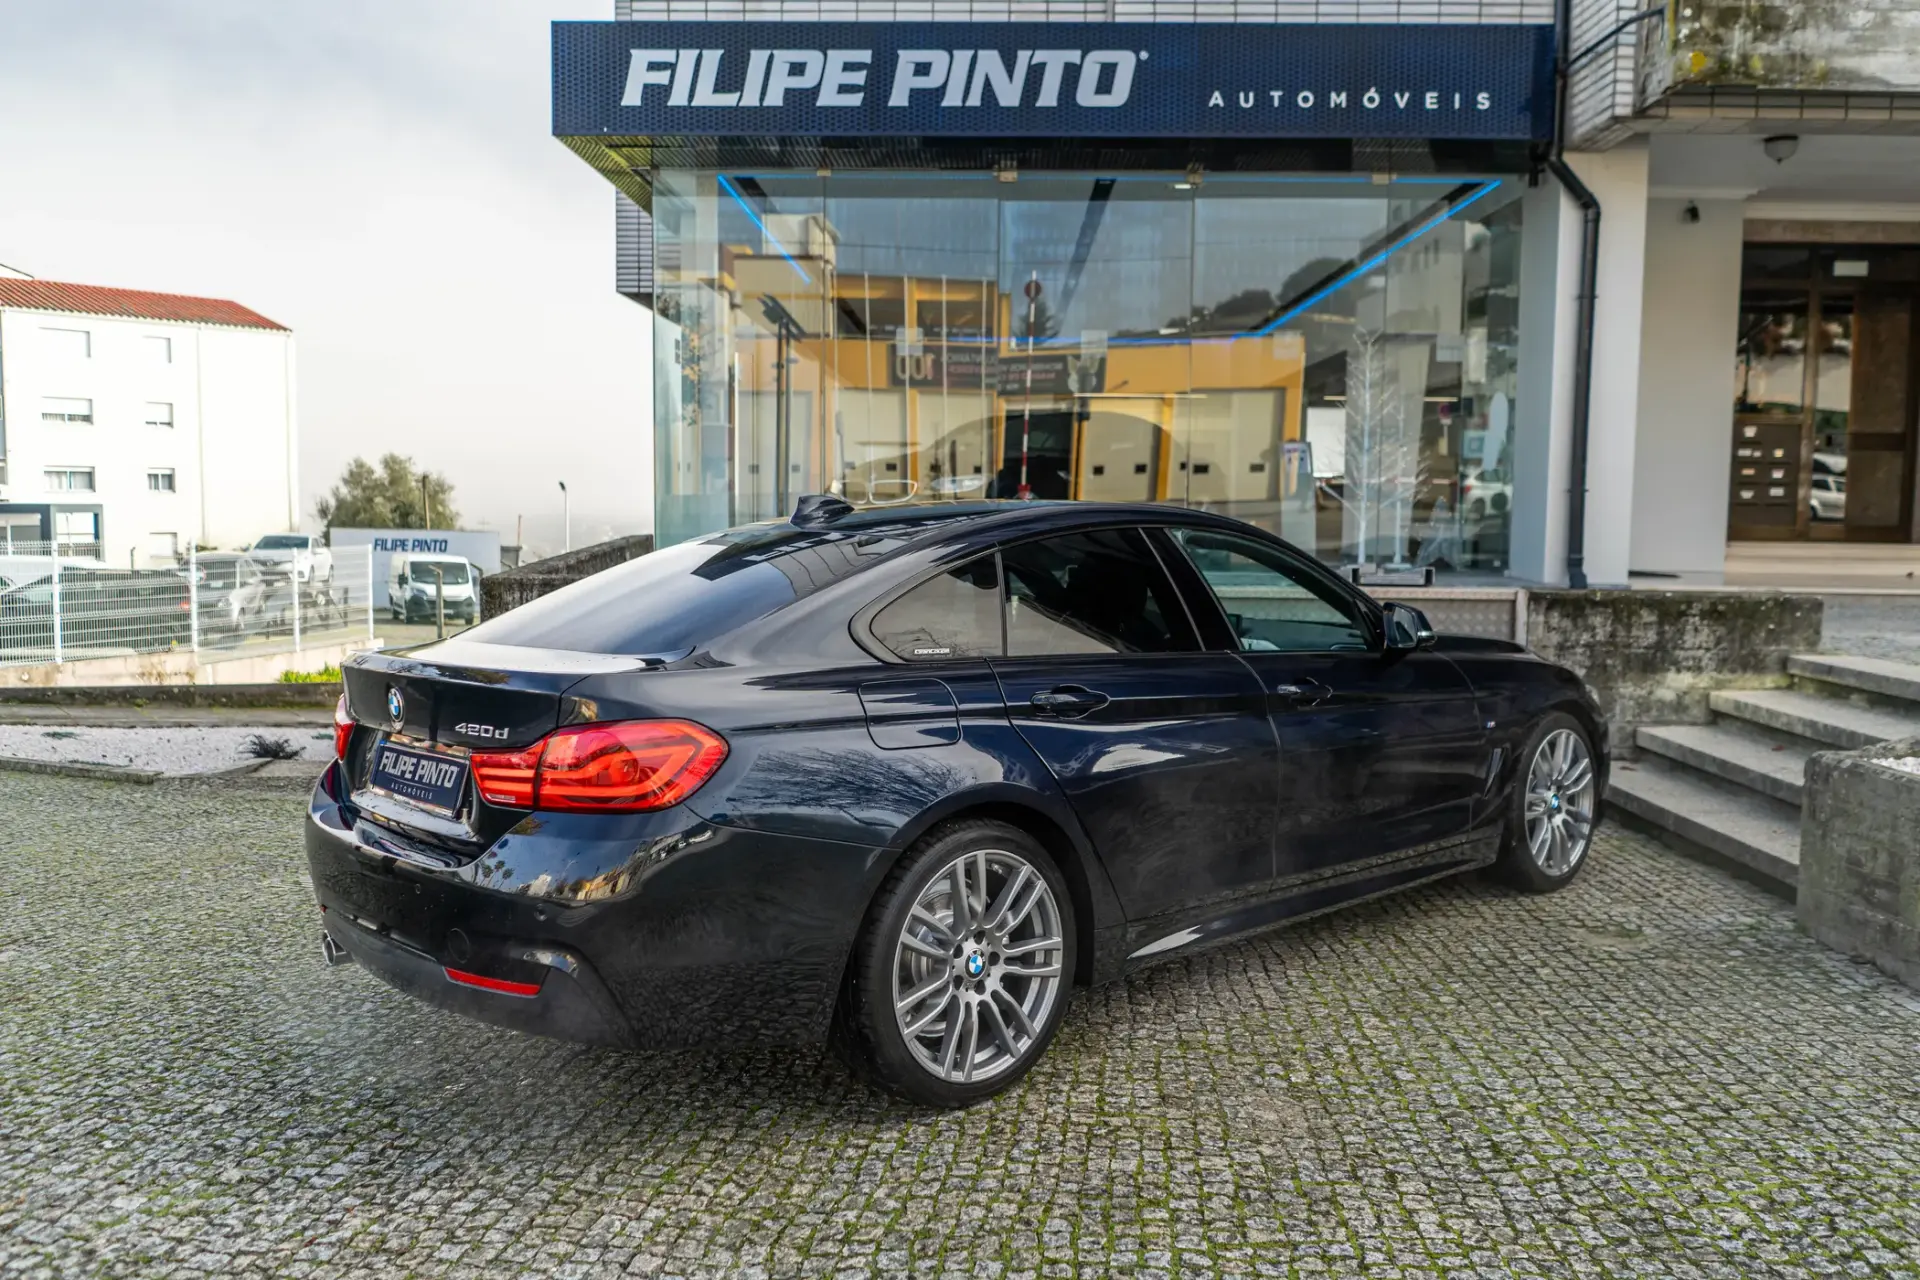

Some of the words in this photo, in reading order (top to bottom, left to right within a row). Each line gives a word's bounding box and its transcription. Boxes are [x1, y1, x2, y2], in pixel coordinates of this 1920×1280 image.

[620, 48, 873, 108] FILIPE
[888, 48, 1138, 108] PINTO
[1208, 86, 1491, 111] AUTOMÓVEIS
[374, 537, 409, 552] FILIPE
[411, 538, 448, 553] PINTO
[454, 722, 509, 739] 420d
[379, 751, 417, 779] FILIPE
[415, 758, 458, 789] PINTO
[390, 781, 434, 800] AUTOMÓVEIS
